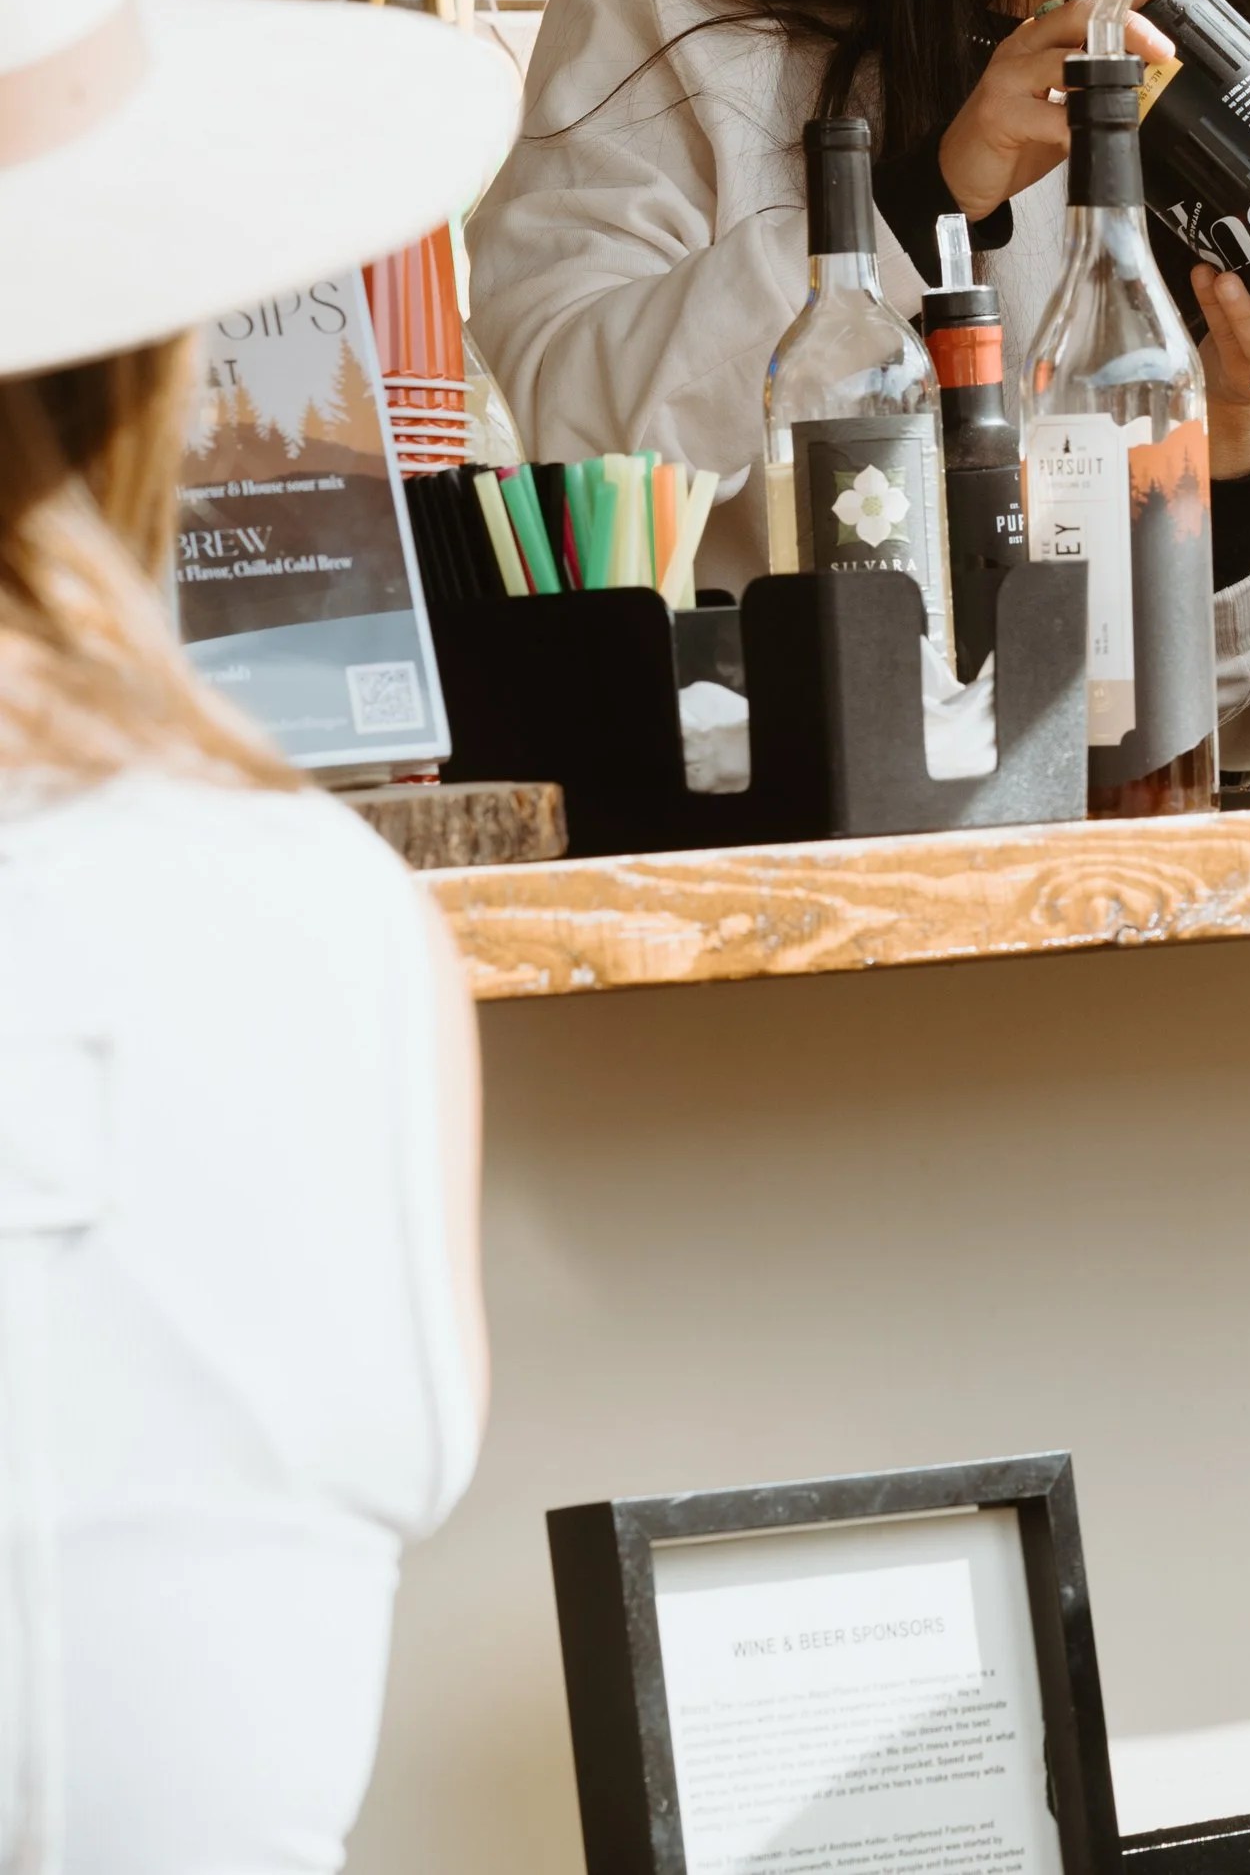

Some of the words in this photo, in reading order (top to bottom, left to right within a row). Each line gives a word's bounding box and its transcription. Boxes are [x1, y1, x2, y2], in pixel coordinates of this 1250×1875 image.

[1039, 457, 1104, 476] PURSUIT
[732, 1637, 778, 1659] WINE
[782, 1634, 794, 1653] &
[799, 1629, 847, 1651] BEER
[852, 1616, 946, 1646] SPONSORS
